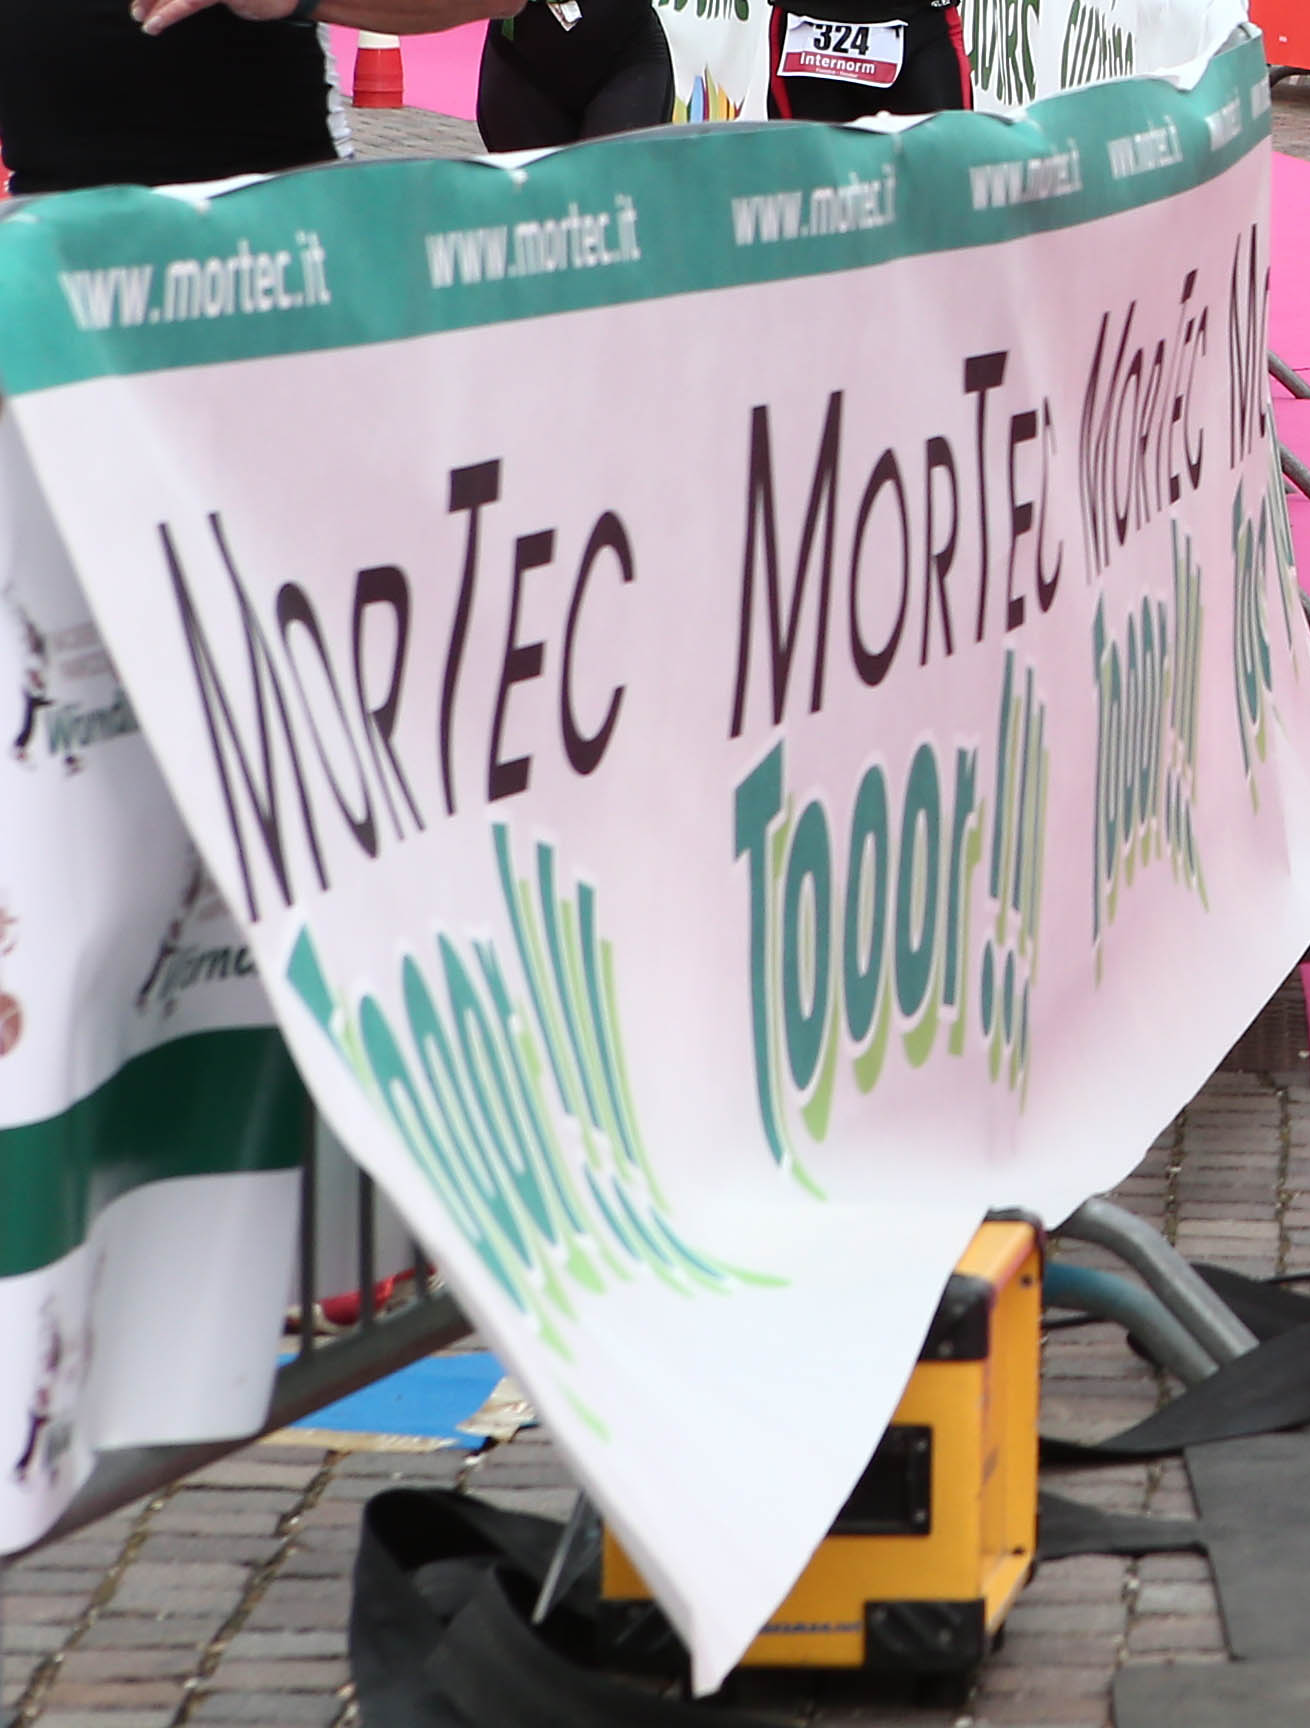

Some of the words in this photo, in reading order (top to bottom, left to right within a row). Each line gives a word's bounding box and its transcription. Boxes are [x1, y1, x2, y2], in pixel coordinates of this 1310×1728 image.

[813, 23, 870, 56] 324
[800, 52, 876, 74] Internorm
[426, 193, 641, 290] www.mortec.it
